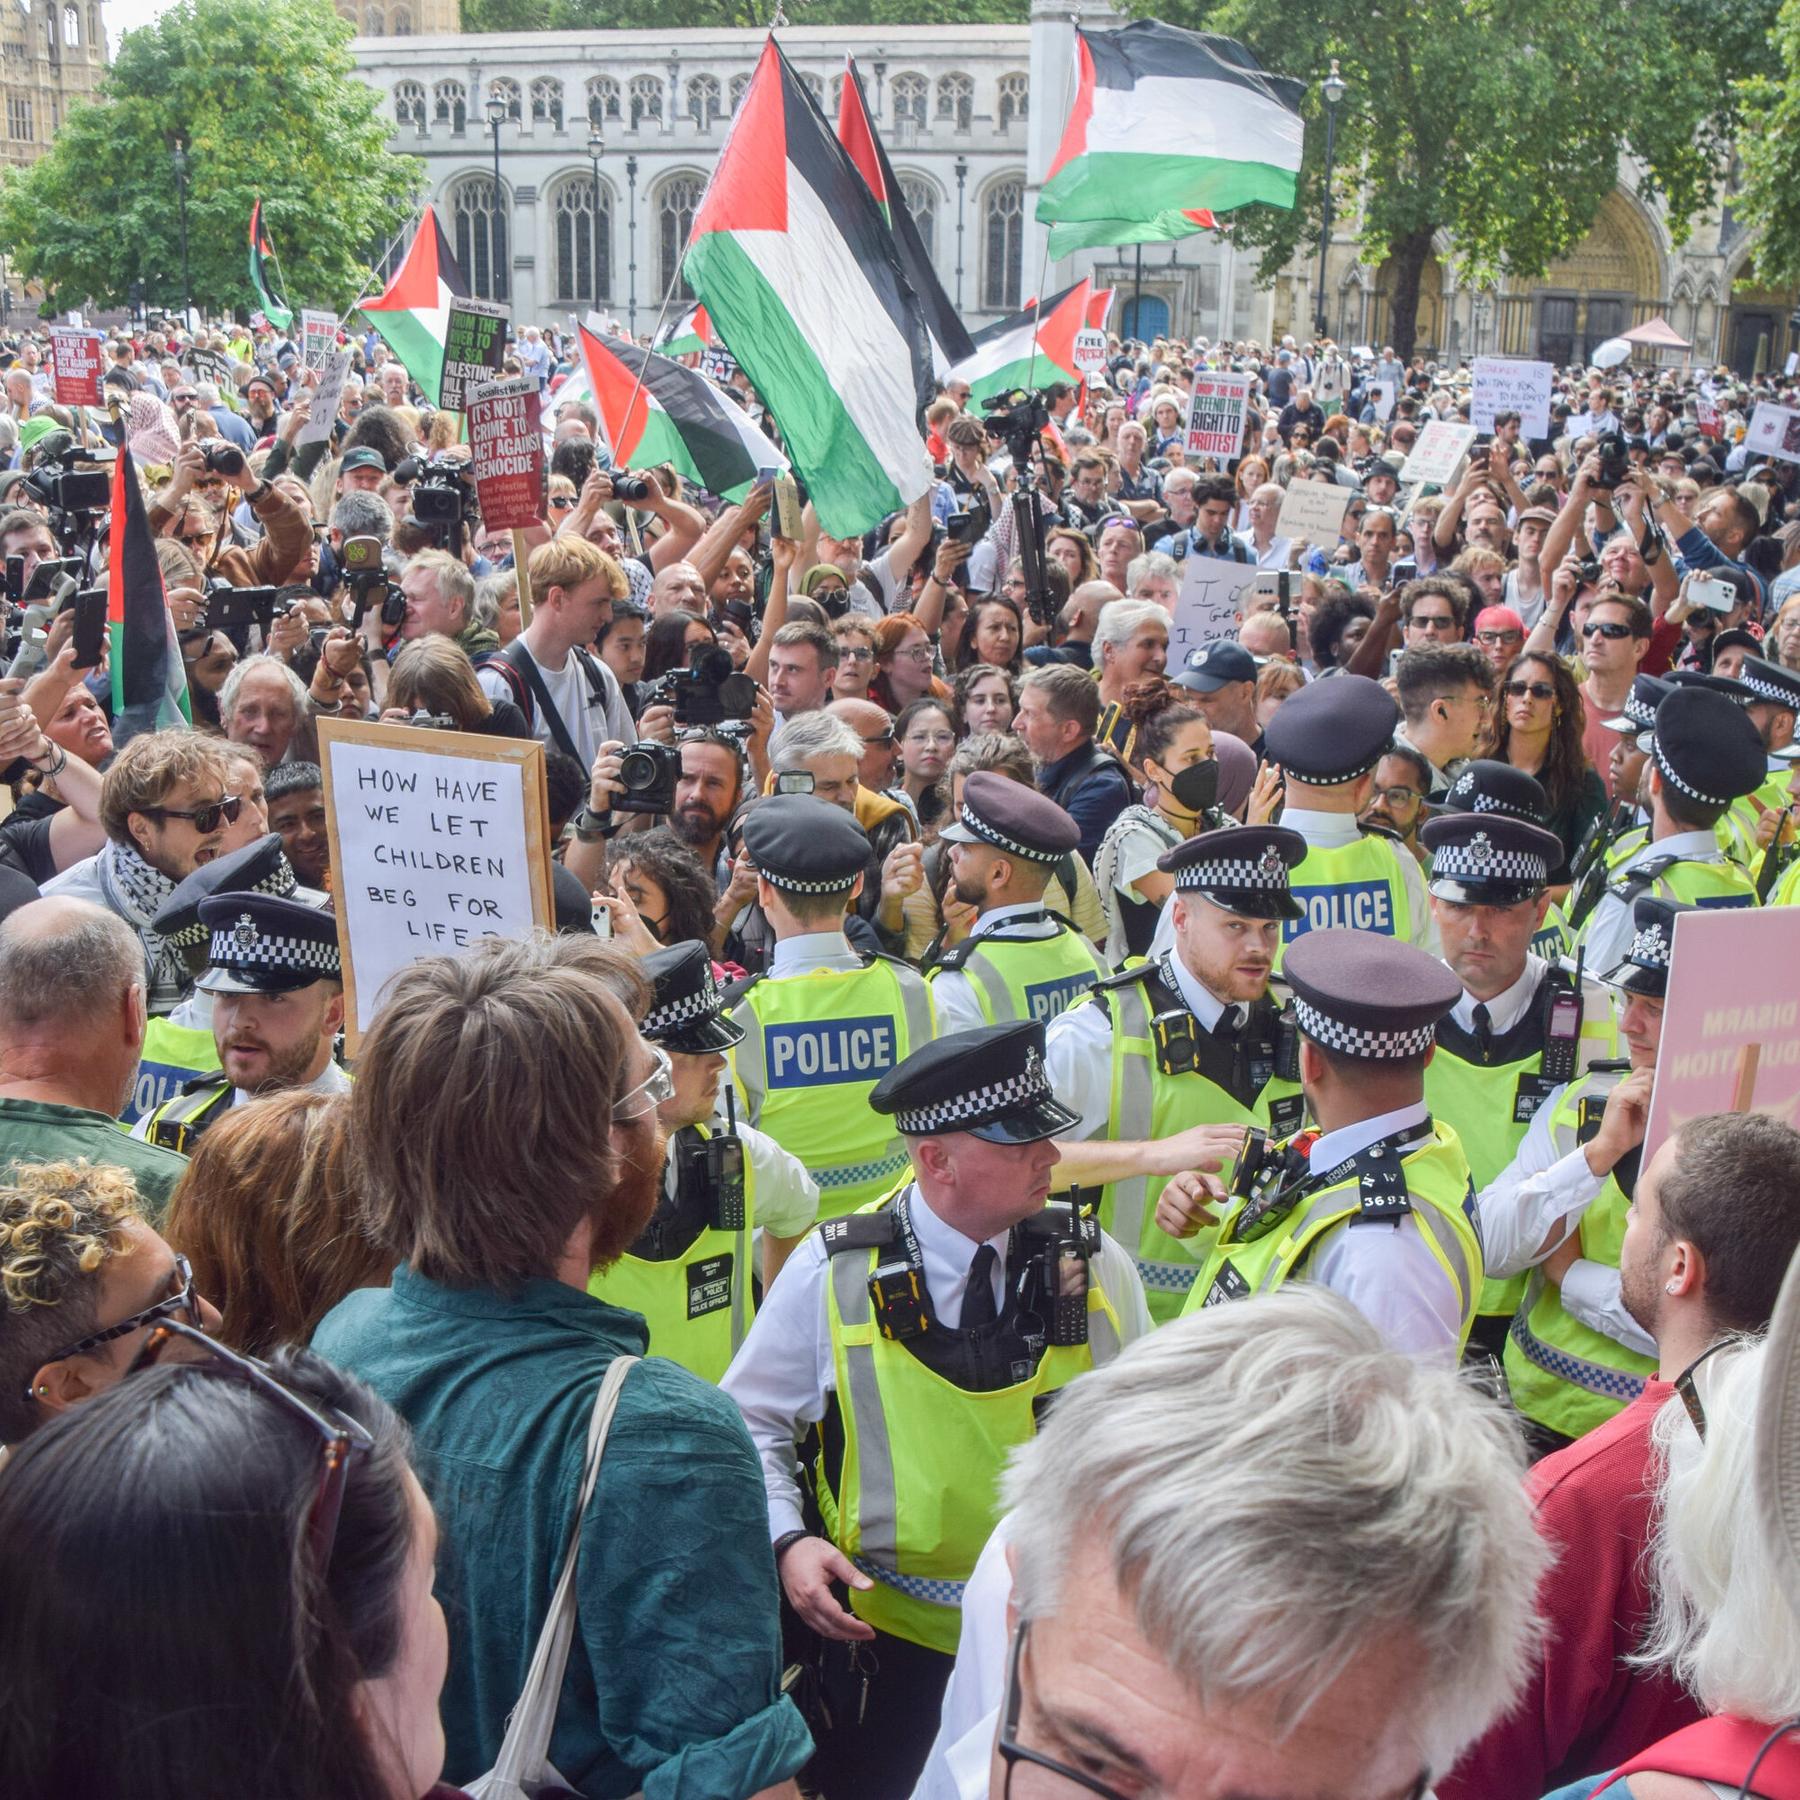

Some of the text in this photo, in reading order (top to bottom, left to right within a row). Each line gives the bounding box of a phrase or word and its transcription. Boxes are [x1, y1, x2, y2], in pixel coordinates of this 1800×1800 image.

[478, 317, 499, 335] THE
[476, 333, 492, 350] TO
[1078, 336, 1103, 348] FREE
[464, 347, 483, 365] SEA
[445, 360, 496, 382] PALESTINE
[441, 391, 462, 410] FREE
[477, 382, 531, 401] Socialist Worker
[1193, 395, 1242, 414] DEFEND THE
[471, 397, 527, 425] IT'S NOT A
[1191, 411, 1241, 434] RIGHT TO
[473, 416, 527, 444] CRIME TO
[1188, 431, 1238, 454] PROTEST
[474, 432, 543, 463] ACT AGAINST
[475, 455, 535, 481] GENOCIDE
[358, 768, 498, 803] HOW HAVE
[365, 804, 489, 838] WE LET
[374, 844, 504, 879] CHILDREN
[367, 886, 503, 920] BEG FOR
[407, 920, 499, 948] LIFE
[772, 1026, 891, 1077] POLICE
[1324, 1158, 1358, 1185] OFFICER
[836, 1221, 848, 1237] NW
[905, 1234, 923, 1269] POLICE
